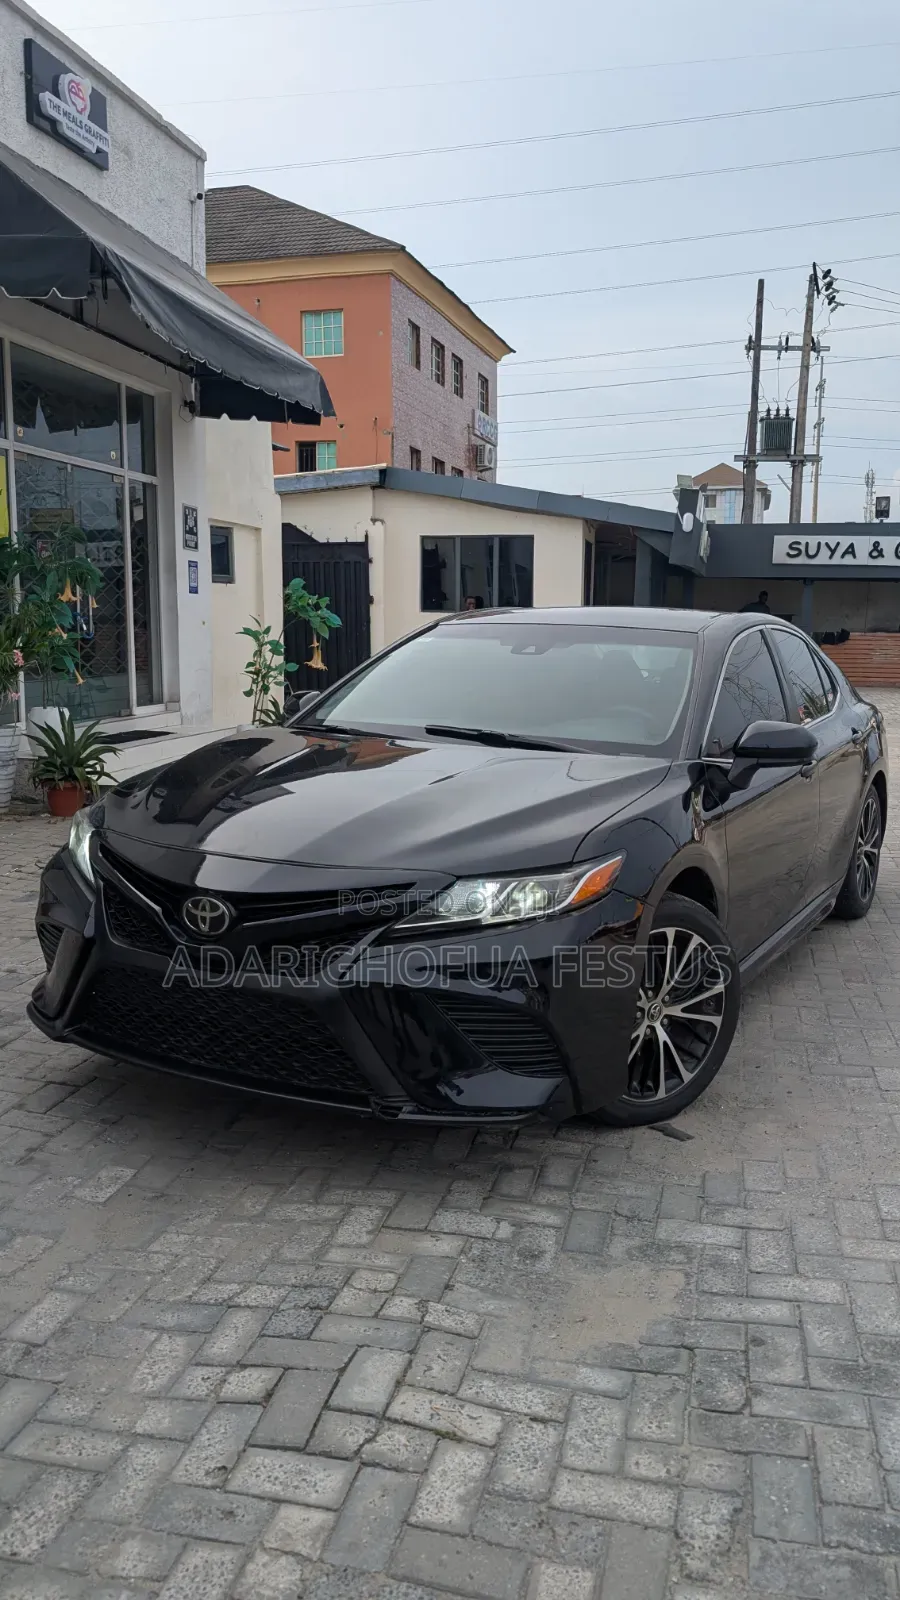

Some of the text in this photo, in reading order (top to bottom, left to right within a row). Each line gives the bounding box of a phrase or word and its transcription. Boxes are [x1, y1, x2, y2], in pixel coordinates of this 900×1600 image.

[48, 98, 110, 149] THE MEALS GRAFFITI
[786, 540, 857, 560] SUYA
[868, 540, 885, 560] &
